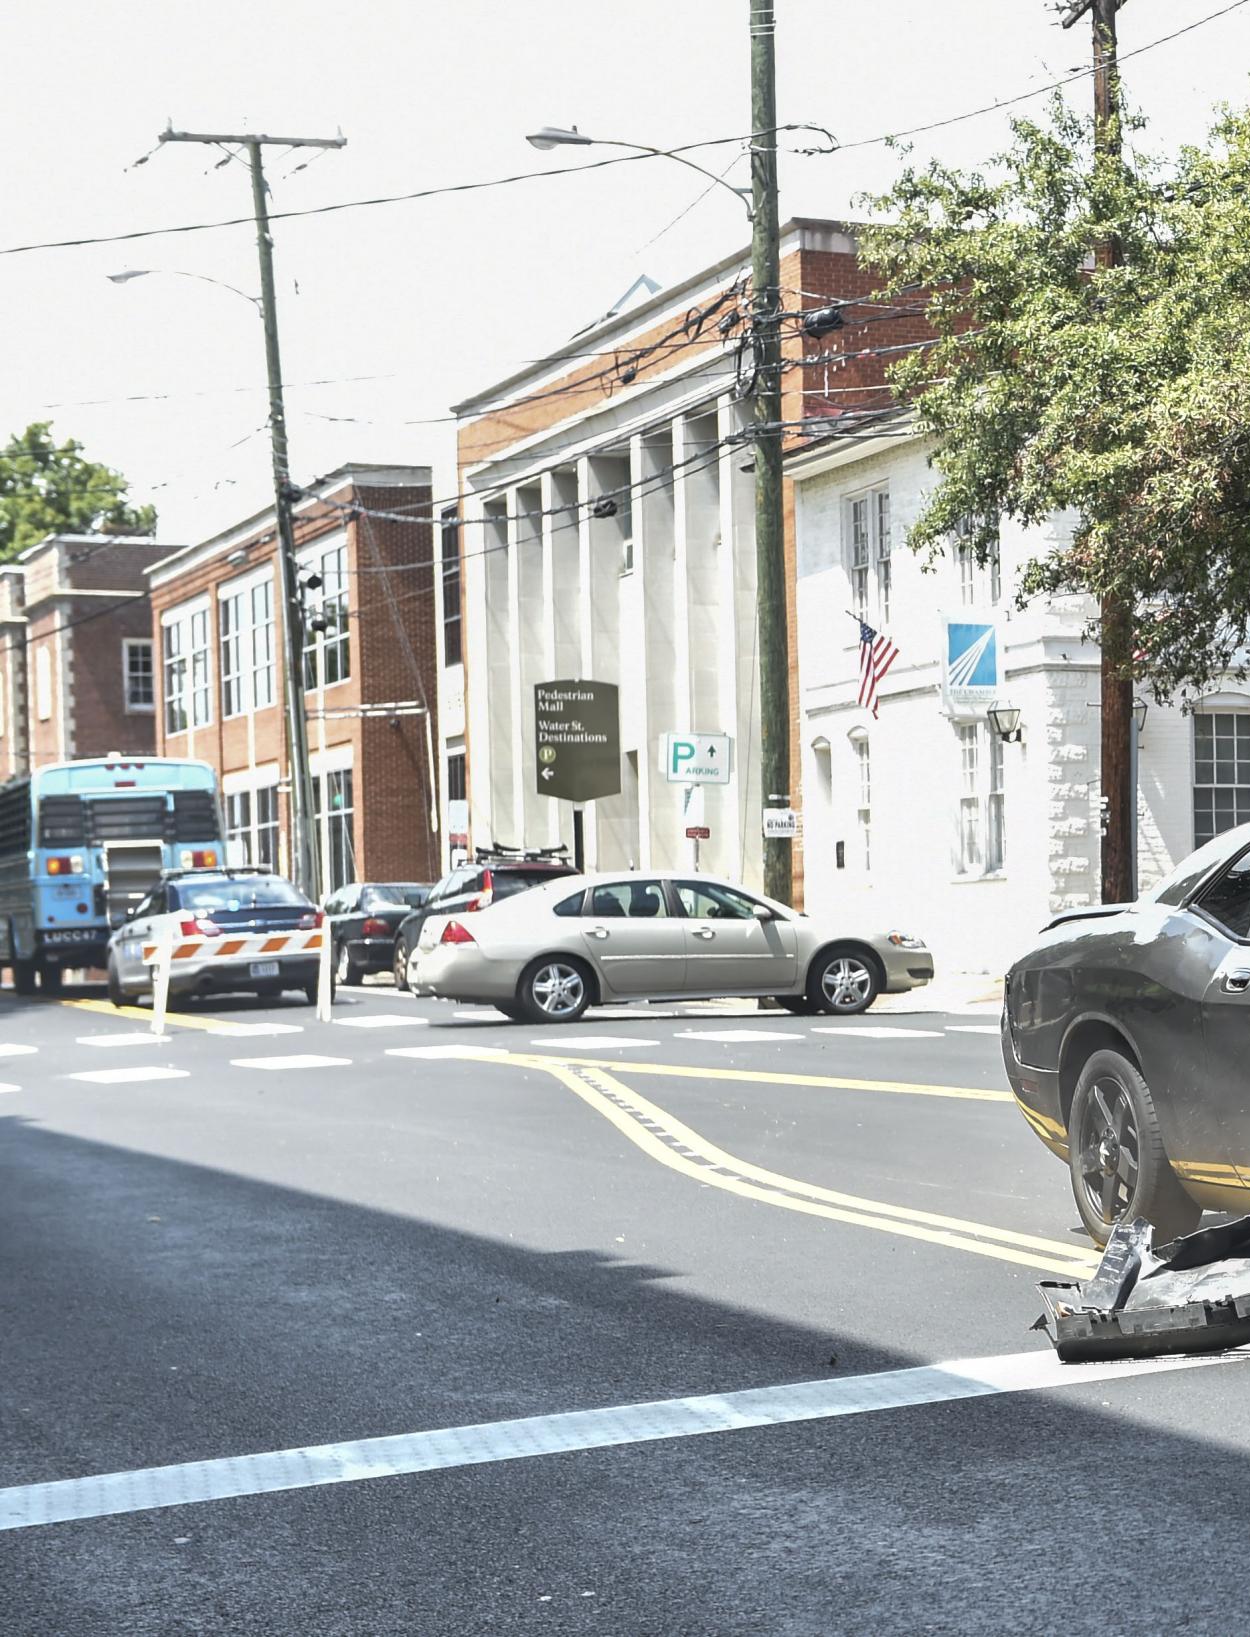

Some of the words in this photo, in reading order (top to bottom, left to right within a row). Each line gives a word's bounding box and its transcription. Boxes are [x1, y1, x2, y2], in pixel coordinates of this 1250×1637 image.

[538, 689, 594, 700] Pedestrian
[538, 701, 563, 711] Mall
[539, 720, 570, 730] Water
[572, 720, 584, 731] St.
[539, 732, 607, 742] Destinations
